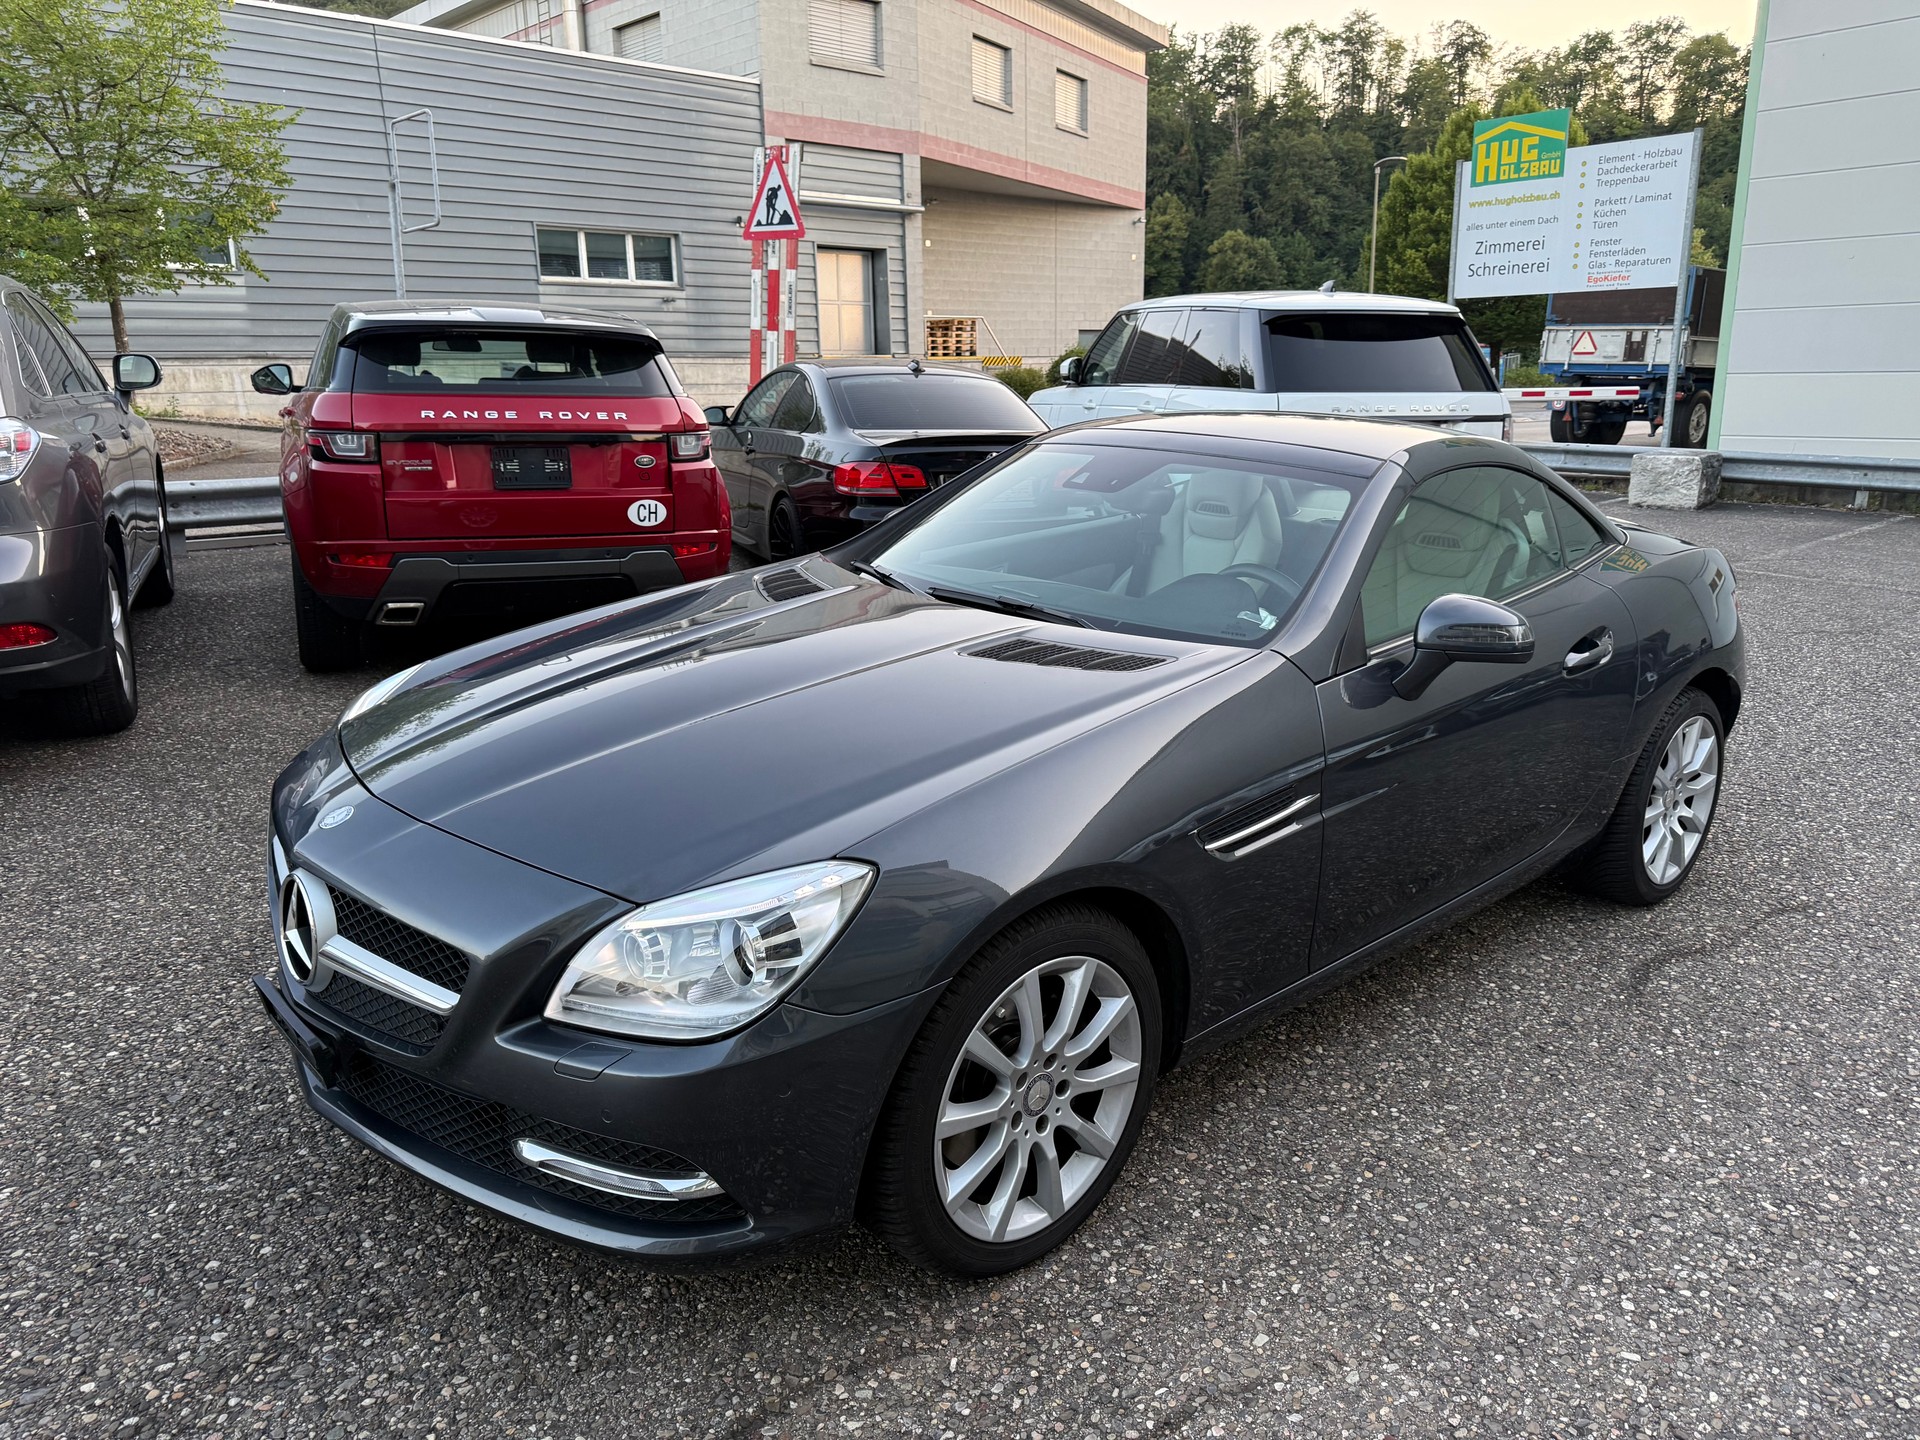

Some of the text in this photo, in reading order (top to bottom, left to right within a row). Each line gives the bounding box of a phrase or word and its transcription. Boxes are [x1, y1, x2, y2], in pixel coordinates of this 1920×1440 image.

[1476, 136, 1539, 183] HUG
[1541, 151, 1561, 159] GmbH
[1598, 153, 1635, 164] Element
[1643, 147, 1683, 159] Holzbau
[1597, 159, 1677, 176] Dachdeckerarbeit
[1596, 175, 1650, 188] Treppenbau
[1594, 196, 1627, 207] Parkett
[1635, 192, 1672, 203] Laminat
[1593, 208, 1627, 218] Küchen
[1466, 215, 1559, 231] alles unter einem Dach
[1592, 220, 1618, 229] Türen
[1475, 235, 1546, 255] Zimmerei
[1590, 238, 1622, 247] Fenster
[1589, 246, 1646, 258] Fensterläden
[1468, 257, 1550, 277] Schreinerei
[1588, 261, 1607, 270] Glas
[1614, 257, 1671, 268] Reparaturen
[1587, 274, 1631, 285] EgoKiefer
[420, 410, 628, 420] RANGE ROVER
[1331, 404, 1471, 413] RANGE ROVER
[637, 503, 658, 523] CH
